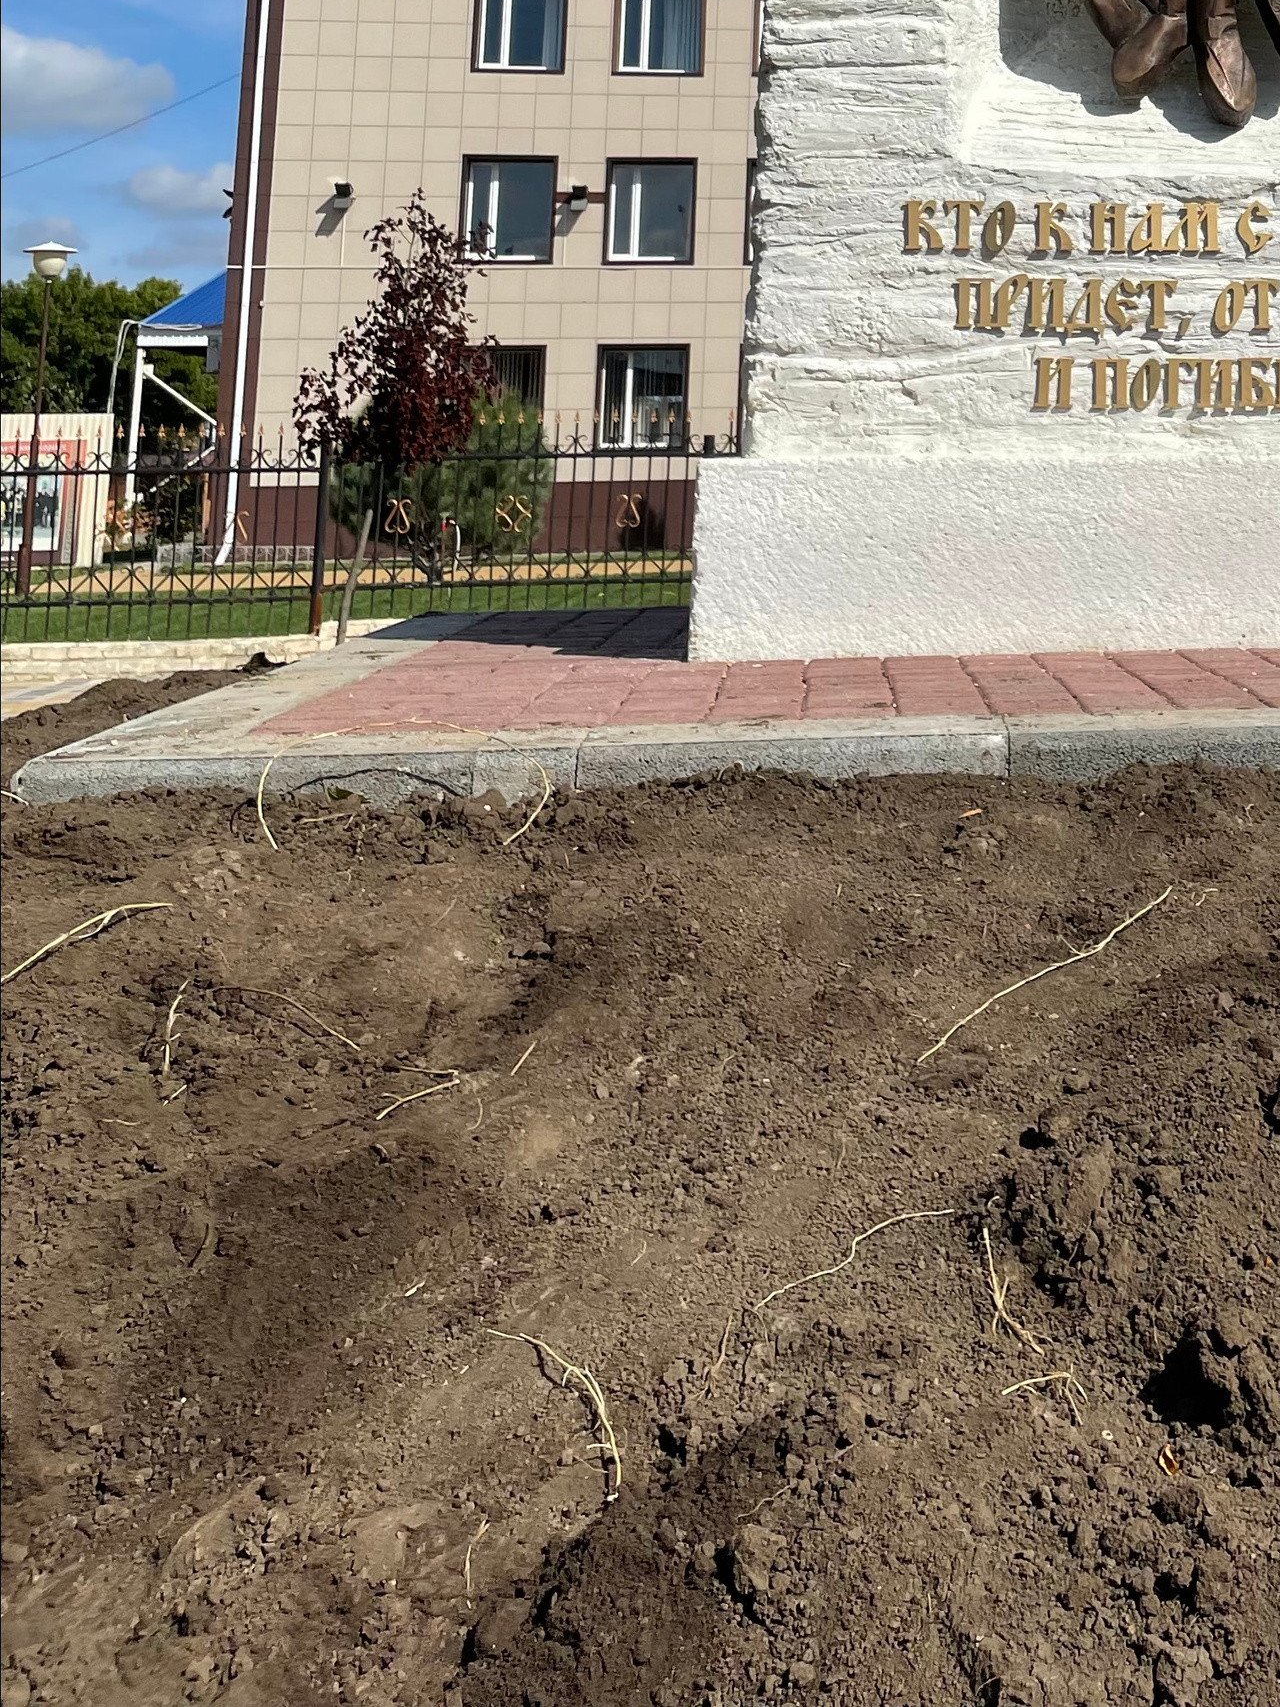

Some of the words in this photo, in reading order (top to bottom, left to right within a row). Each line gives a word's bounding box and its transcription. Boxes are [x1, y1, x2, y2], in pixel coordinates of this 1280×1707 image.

[901, 200, 1016, 253] КТО
[1035, 202, 1075, 252] К
[1090, 202, 1221, 253] НАМ
[1236, 199, 1274, 254] С
[953, 274, 1195, 338] ПРИДЕТ,
[1034, 357, 1075, 409] И
